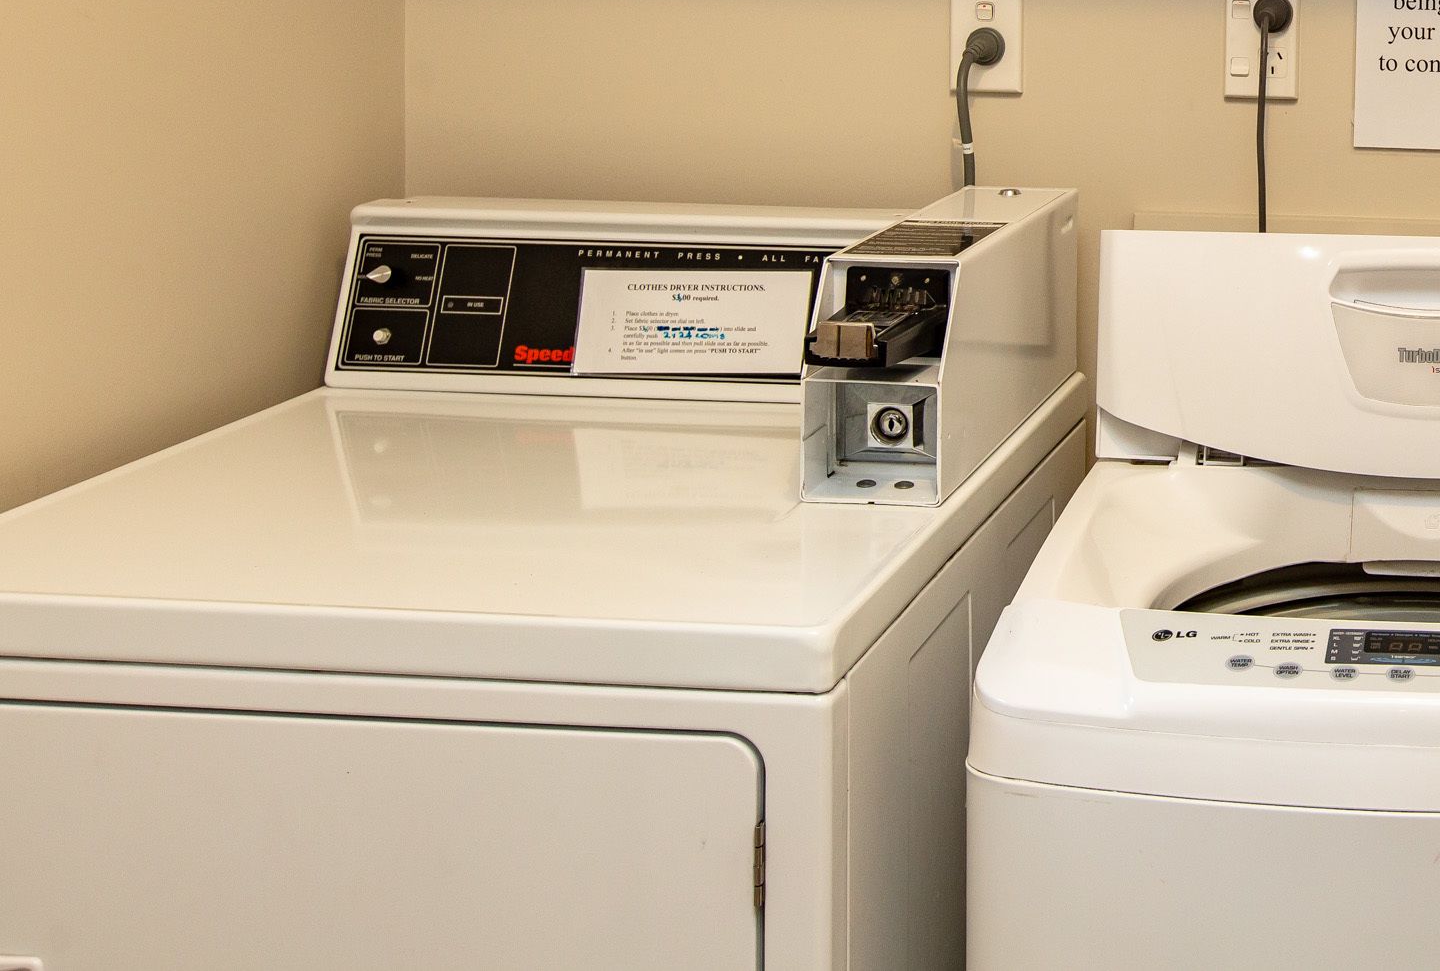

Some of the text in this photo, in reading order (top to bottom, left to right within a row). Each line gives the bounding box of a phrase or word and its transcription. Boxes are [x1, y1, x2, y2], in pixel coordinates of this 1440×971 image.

[1388, 26, 1435, 44] your
[1379, 56, 1397, 72] to
[578, 249, 660, 259] PERMANENT
[677, 252, 721, 261] PRESS
[762, 254, 785, 262] ALL
[627, 283, 668, 291] CLOTHES
[701, 284, 765, 292] INSTRUCTIONS.
[514, 344, 575, 364] Speed
[1176, 630, 1197, 638] LG
